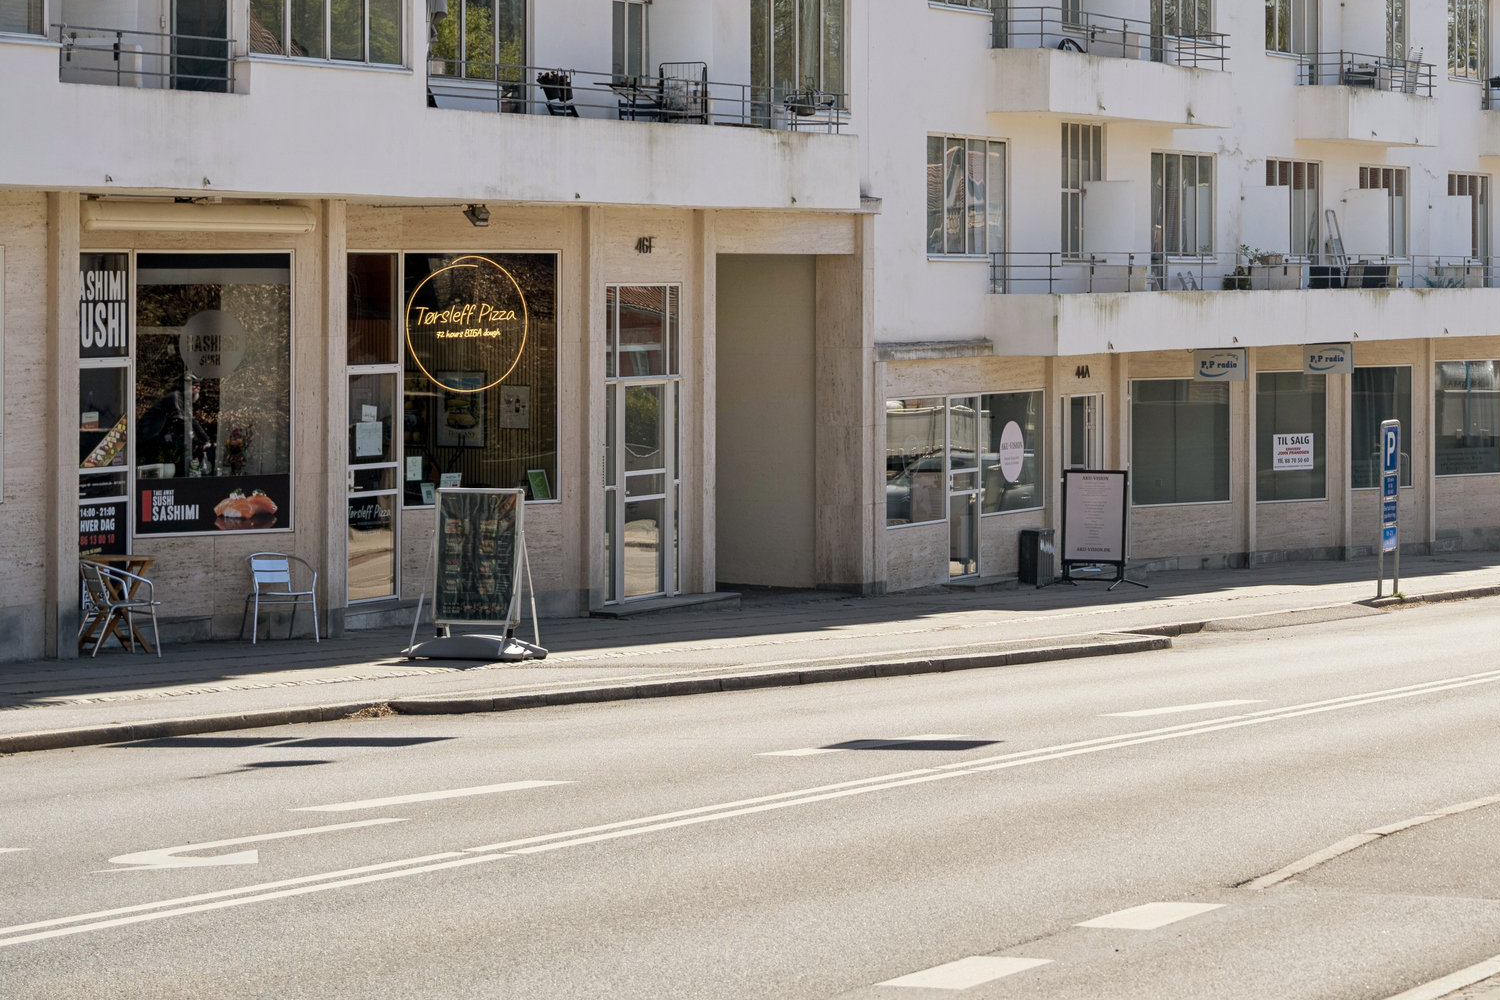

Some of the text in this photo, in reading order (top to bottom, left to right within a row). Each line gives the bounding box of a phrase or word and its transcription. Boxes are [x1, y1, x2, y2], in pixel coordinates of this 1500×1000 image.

[415, 303, 517, 326] Tørsleff Pizza
[1217, 360, 1238, 368] radio
[1325, 354, 1344, 362] radio
[1278, 436, 1309, 445] TIL SALG
[1387, 431, 1396, 466] P
[152, 495, 174, 506] SUSHI
[152, 504, 199, 521] SASHIMI
[80, 518, 115, 532] HVER DAG
